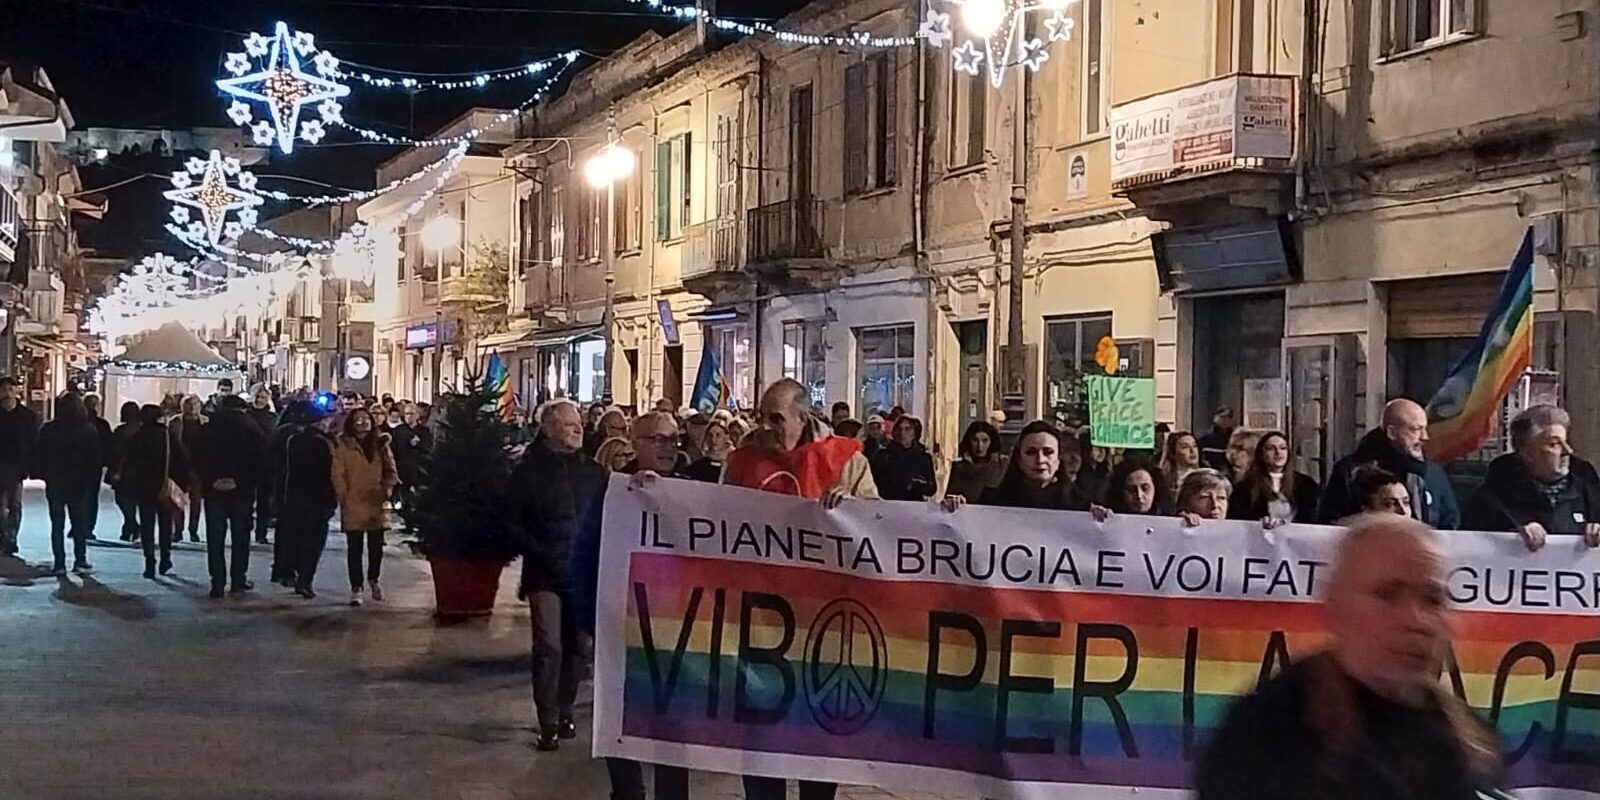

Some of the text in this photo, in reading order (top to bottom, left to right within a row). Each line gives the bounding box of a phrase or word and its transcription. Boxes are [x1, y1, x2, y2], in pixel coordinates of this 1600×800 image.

[1115, 114, 1170, 161] gabetti
[1242, 115, 1288, 131] gabetti
[1091, 377, 1136, 402] GIVE
[1092, 401, 1144, 423] PEACE
[640, 511, 674, 548] IL
[688, 517, 882, 574] PIANETA
[897, 538, 1081, 586] BRUCIA
[1095, 550, 1126, 588] E
[1143, 553, 1224, 593] VOI
[1243, 558, 1328, 596] FAT
[923, 611, 1140, 759] PER
